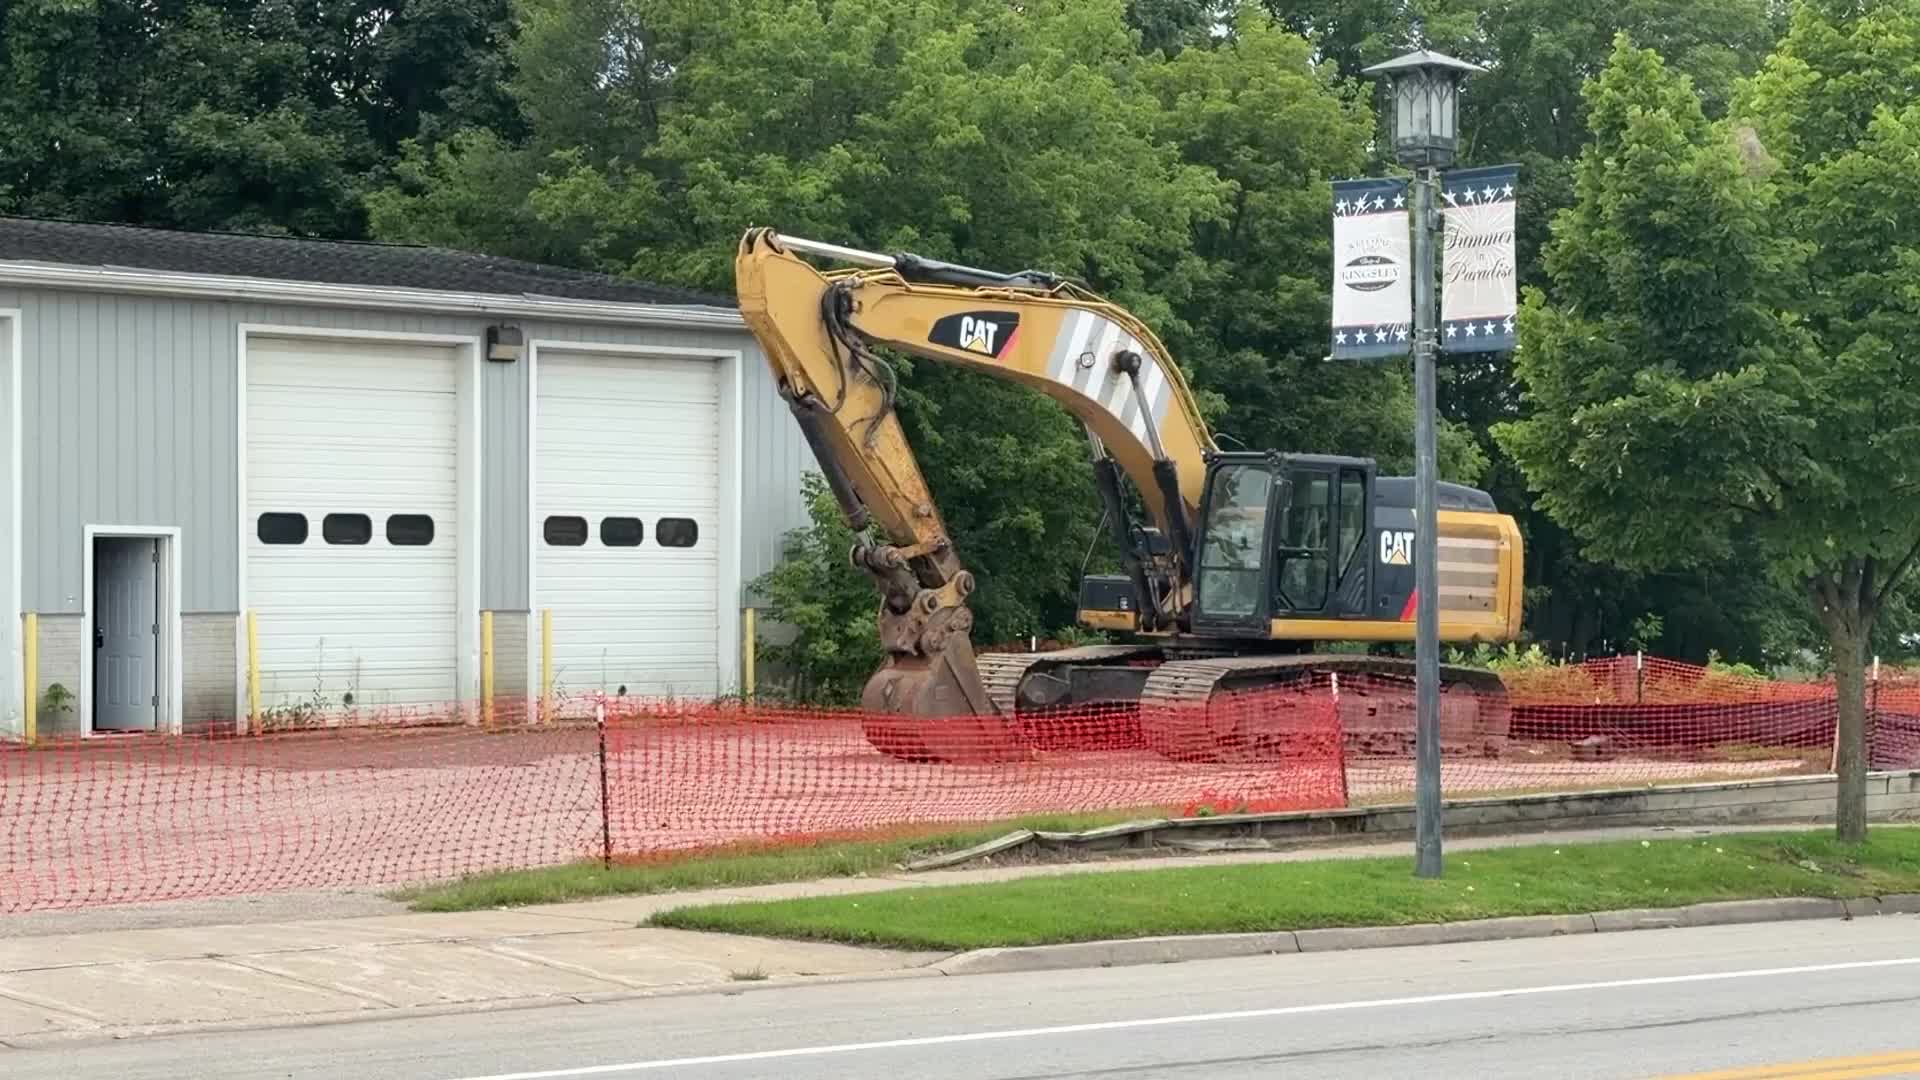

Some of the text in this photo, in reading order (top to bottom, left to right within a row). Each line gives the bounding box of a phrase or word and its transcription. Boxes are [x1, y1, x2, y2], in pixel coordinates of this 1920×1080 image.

[1444, 226, 1513, 249] Summer
[1342, 267, 1400, 281] KINGSLEY
[1444, 257, 1513, 283] Paradise
[960, 316, 998, 355] CAT
[1381, 530, 1414, 565] CAT
